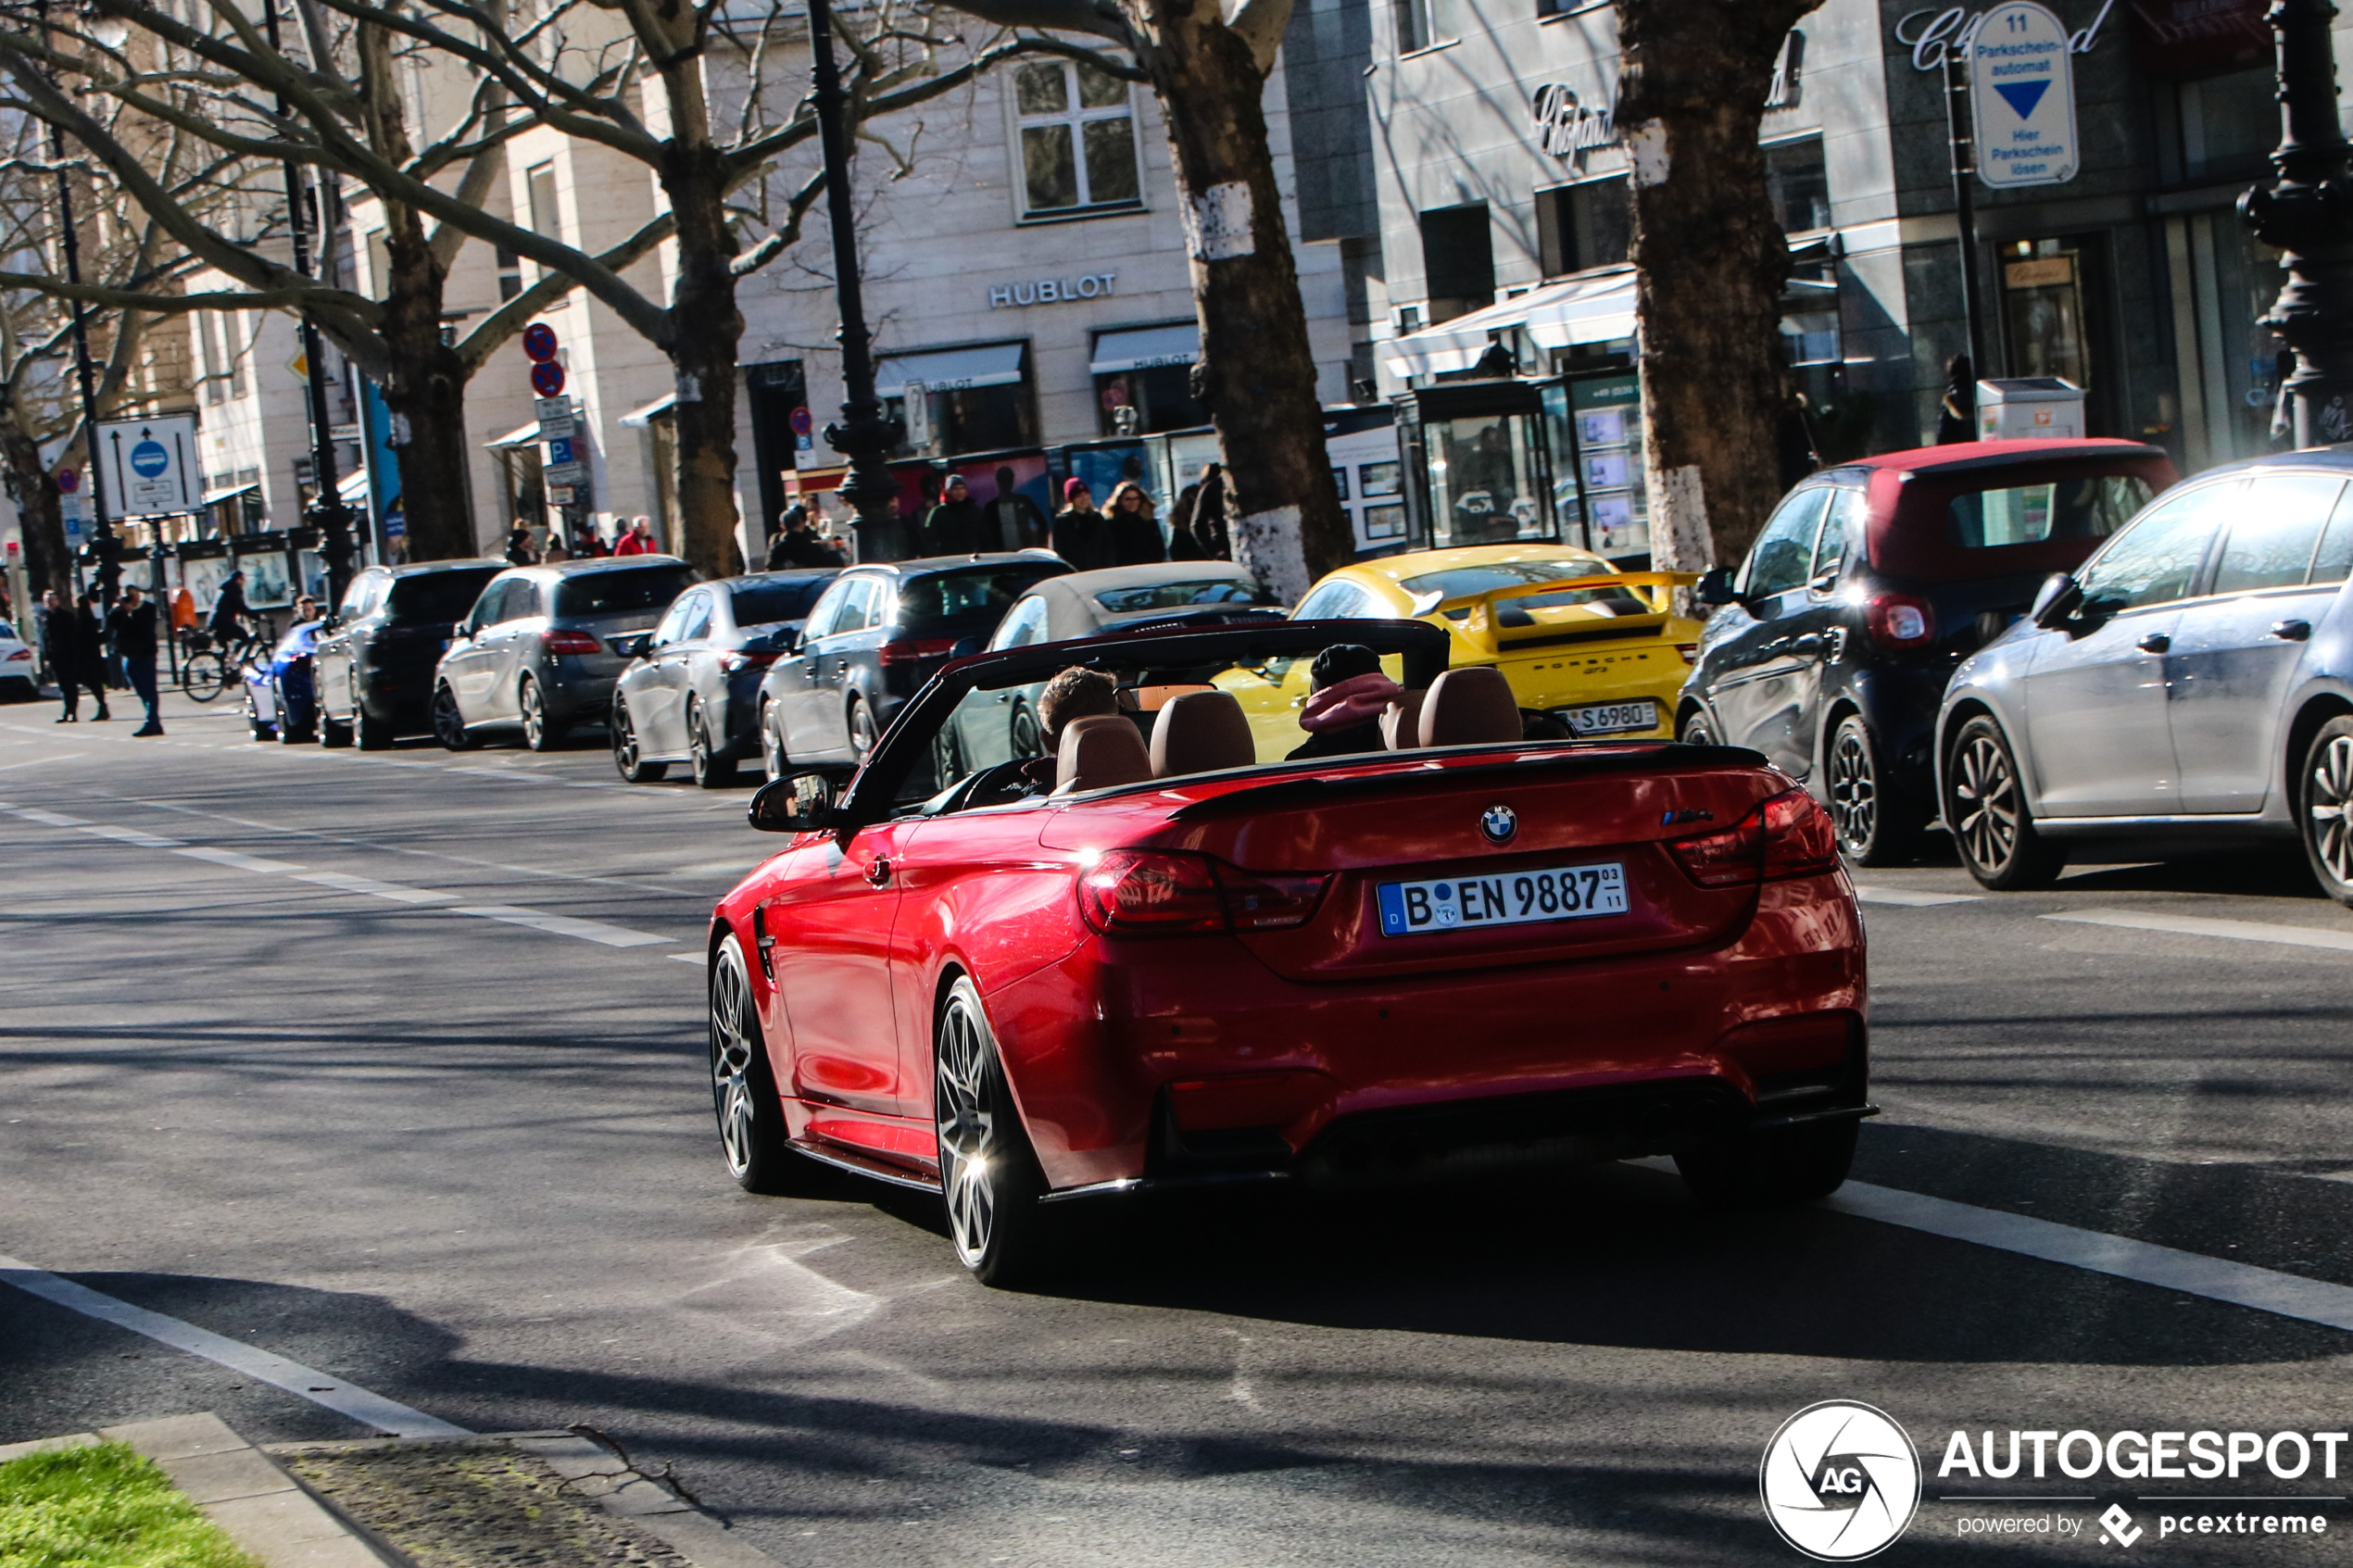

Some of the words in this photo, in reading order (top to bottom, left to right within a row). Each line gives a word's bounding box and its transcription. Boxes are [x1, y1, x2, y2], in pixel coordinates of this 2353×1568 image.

[2006, 13, 2028, 33] 11
[1977, 40, 2063, 59] Parkschein-
[1992, 59, 2051, 77] automat
[2012, 129, 2041, 142] Hier
[1992, 144, 2064, 160] Parkschein
[2010, 162, 2047, 175] lösen
[988, 273, 1117, 309] HUBLOT
[1133, 354, 1189, 370] HUBLOT
[925, 378, 973, 395] UBLOT
[1598, 704, 1642, 727] 6980
[1484, 806, 1514, 820] BMW
[1602, 869, 1618, 881] 03
[1404, 886, 1432, 926] B
[1458, 879, 1506, 922] EN
[1515, 870, 1600, 916] 9887
[1606, 895, 1621, 908] 11
[1390, 913, 1399, 924] D
